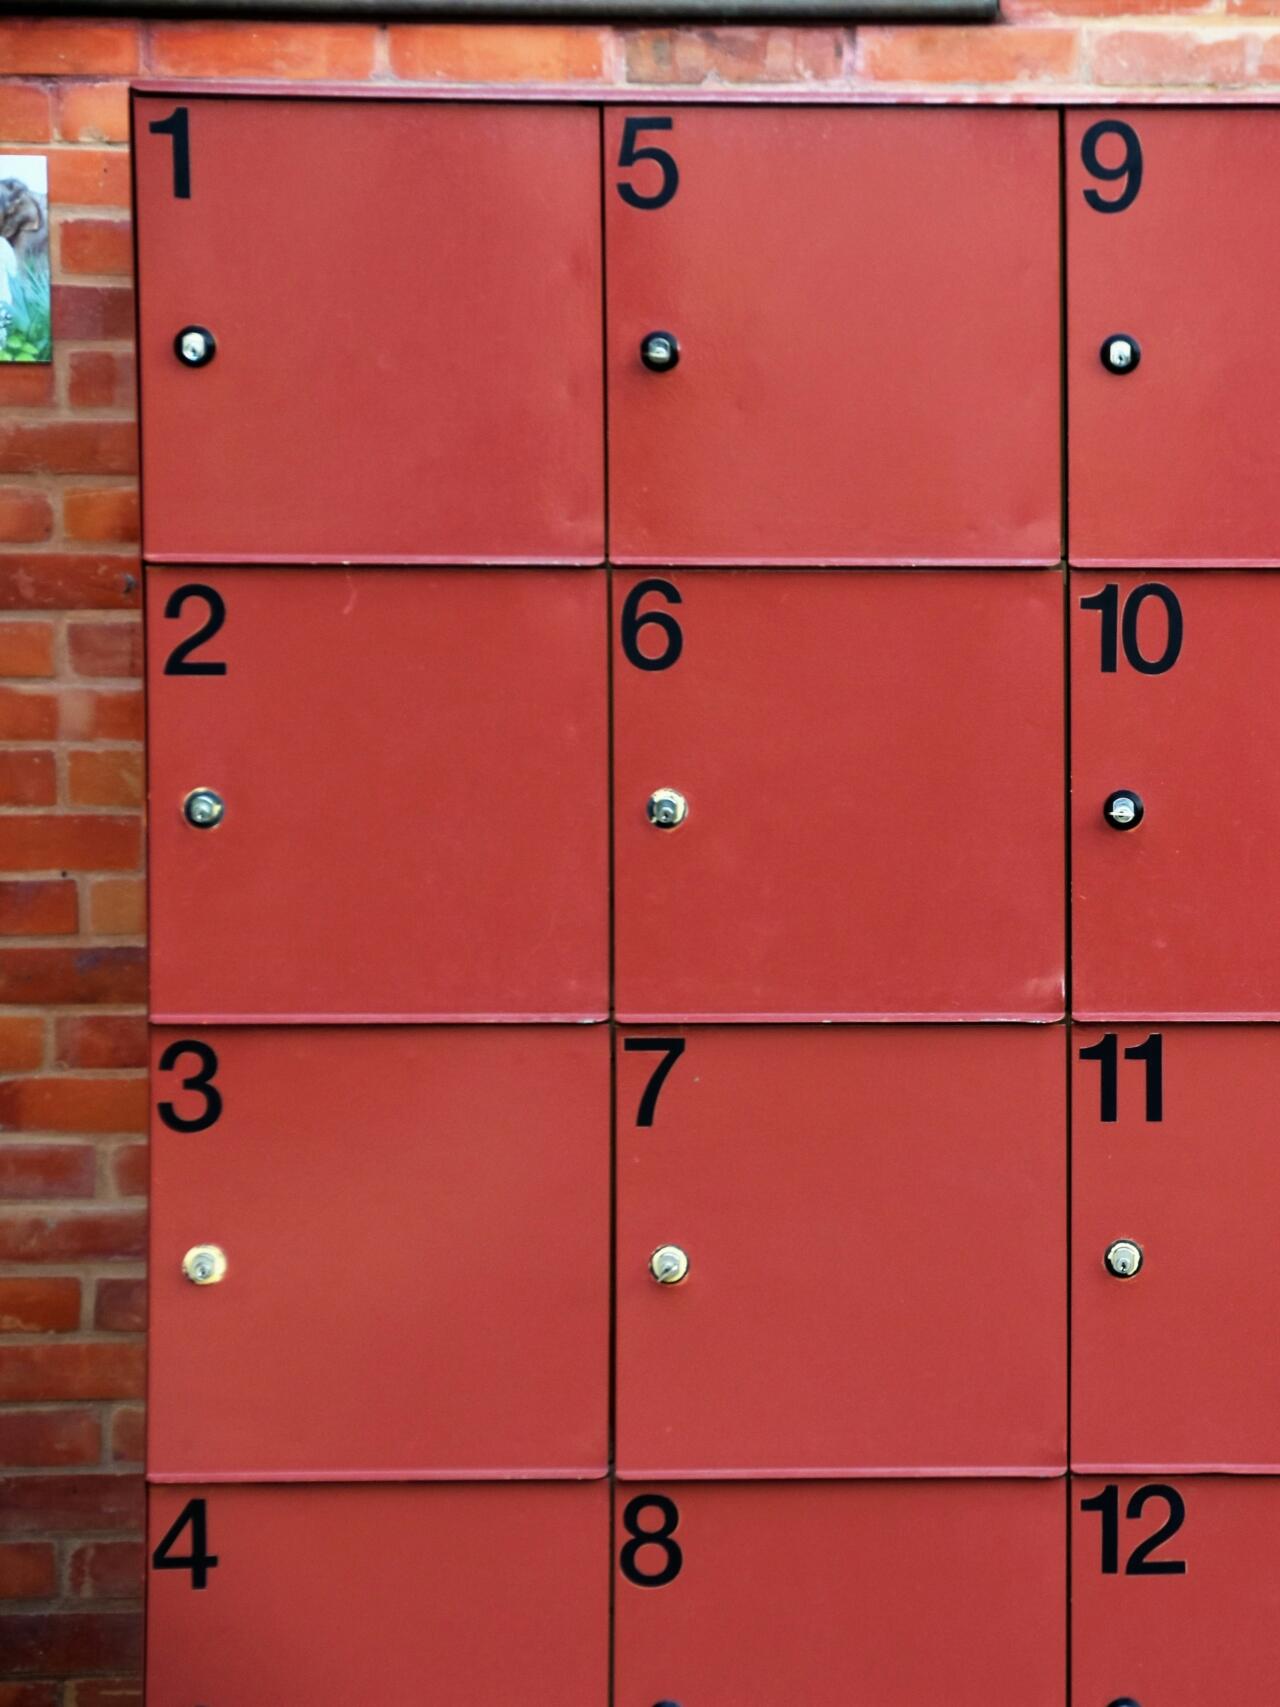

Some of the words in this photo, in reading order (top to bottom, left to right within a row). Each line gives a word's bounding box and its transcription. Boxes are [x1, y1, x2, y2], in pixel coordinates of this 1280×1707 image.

[149, 107, 191, 199] 1
[617, 117, 679, 210] 5
[1081, 119, 1142, 213] 9
[164, 584, 226, 675] 2
[621, 579, 682, 671] 6
[1081, 583, 1183, 674] 10
[158, 1039, 222, 1133] 3
[624, 1038, 685, 1127] 7
[1080, 1033, 1162, 1122] 11
[152, 1500, 219, 1589] 4
[620, 1493, 682, 1587] 8
[1081, 1484, 1185, 1575] 12
